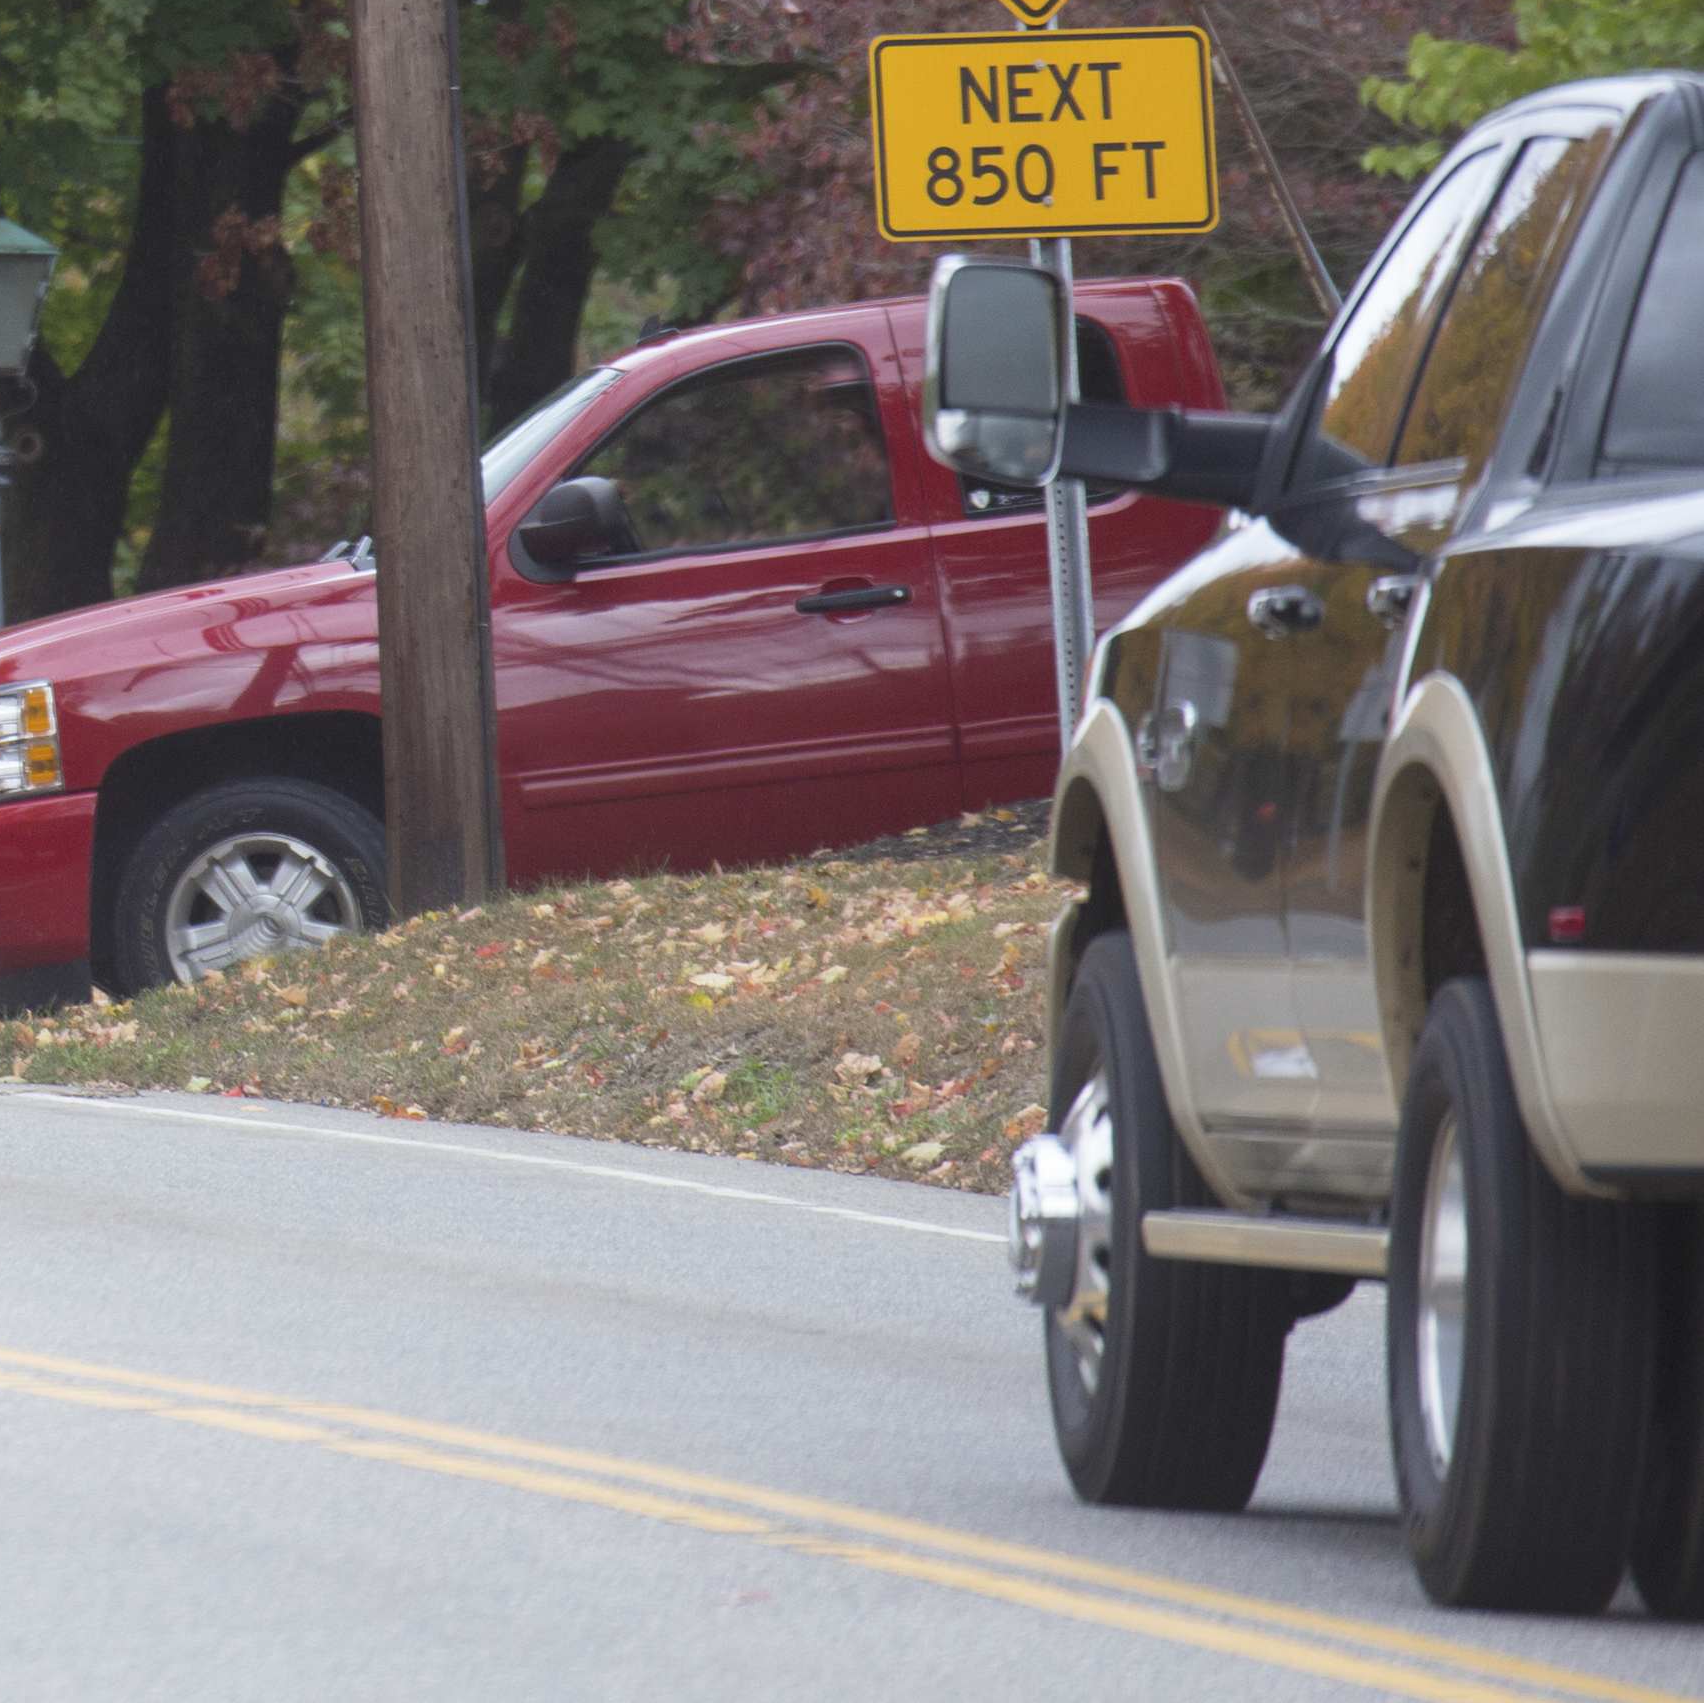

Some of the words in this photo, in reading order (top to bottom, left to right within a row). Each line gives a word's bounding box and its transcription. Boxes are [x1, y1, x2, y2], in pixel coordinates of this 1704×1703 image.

[959, 62, 1121, 124] NEXT
[926, 144, 1055, 207] 850
[1093, 141, 1166, 201] FT
